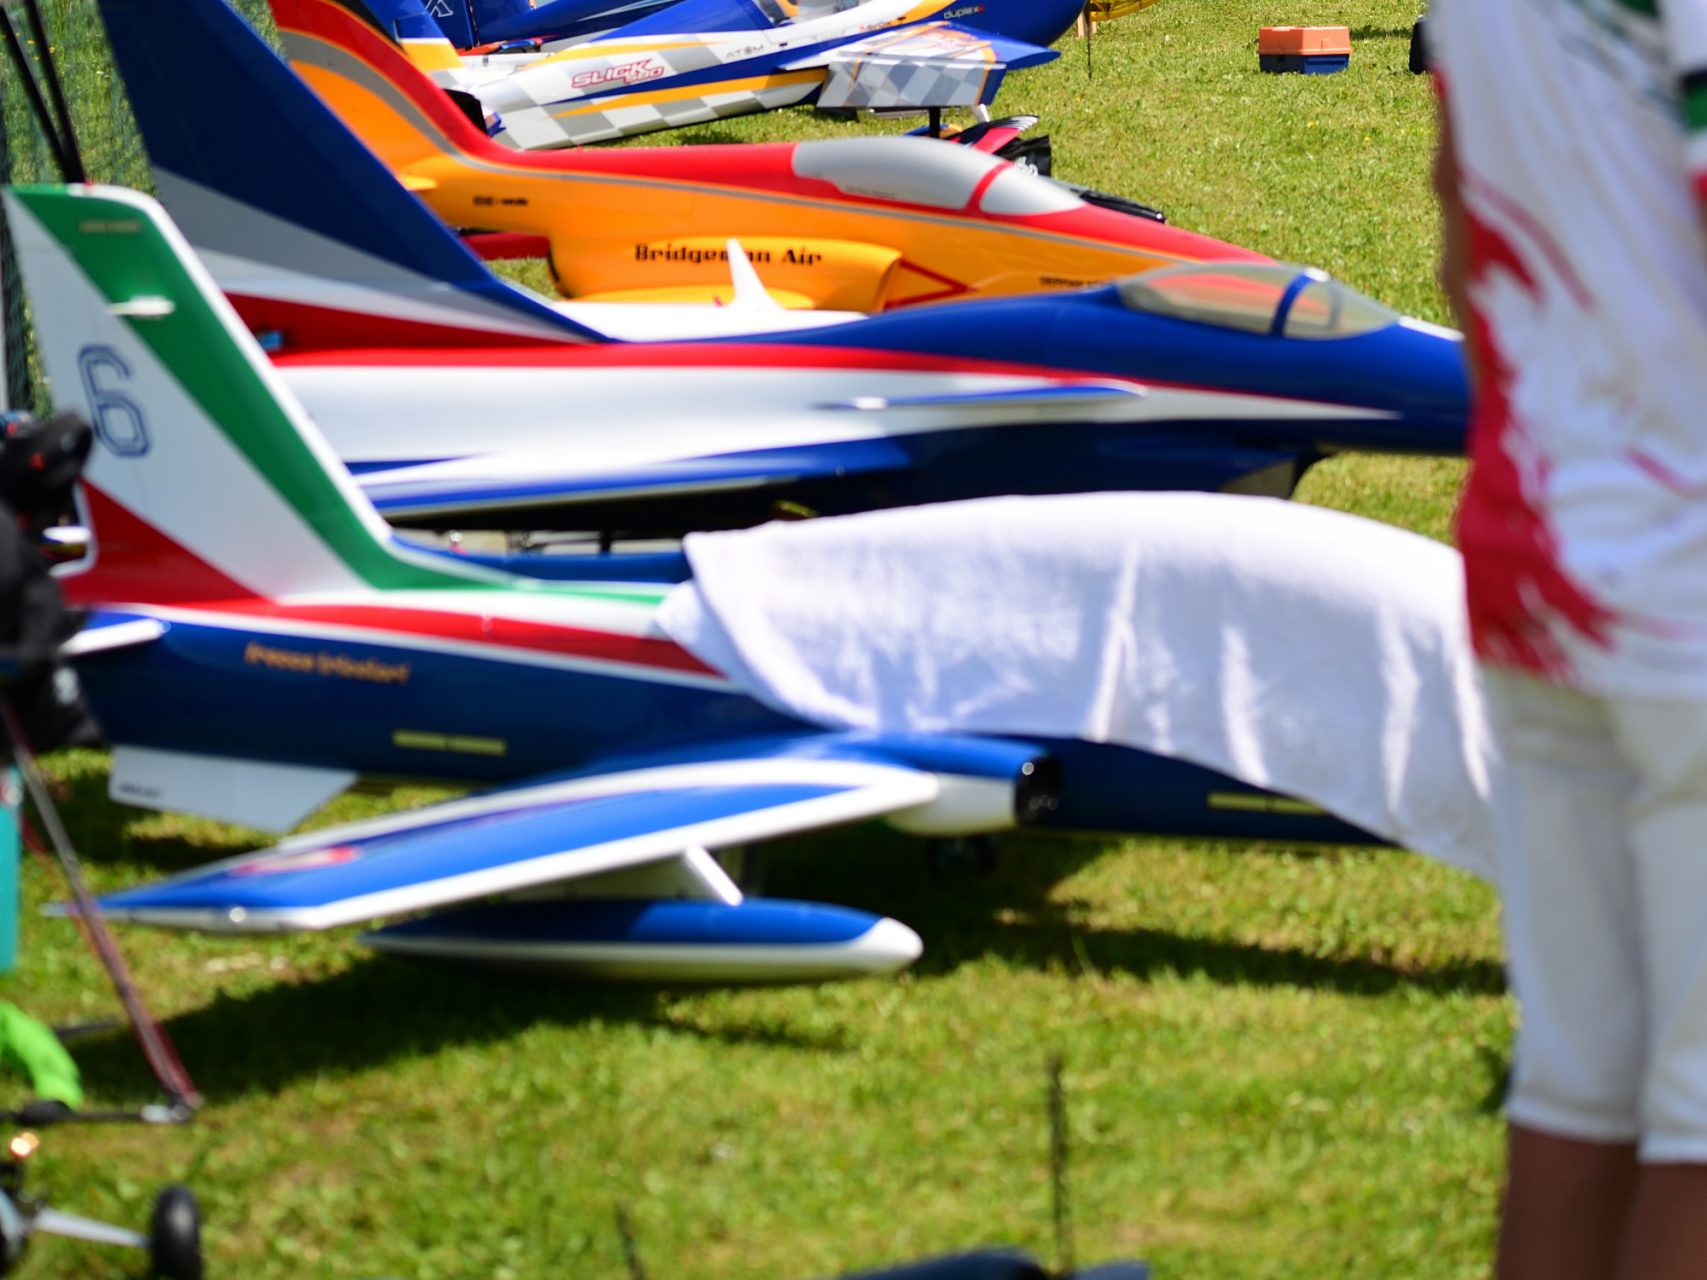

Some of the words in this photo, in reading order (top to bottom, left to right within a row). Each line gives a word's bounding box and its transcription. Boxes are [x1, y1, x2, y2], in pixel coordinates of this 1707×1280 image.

[571, 58, 654, 88] SLICK
[780, 248, 821, 265] Air
[78, 344, 150, 457] 6
